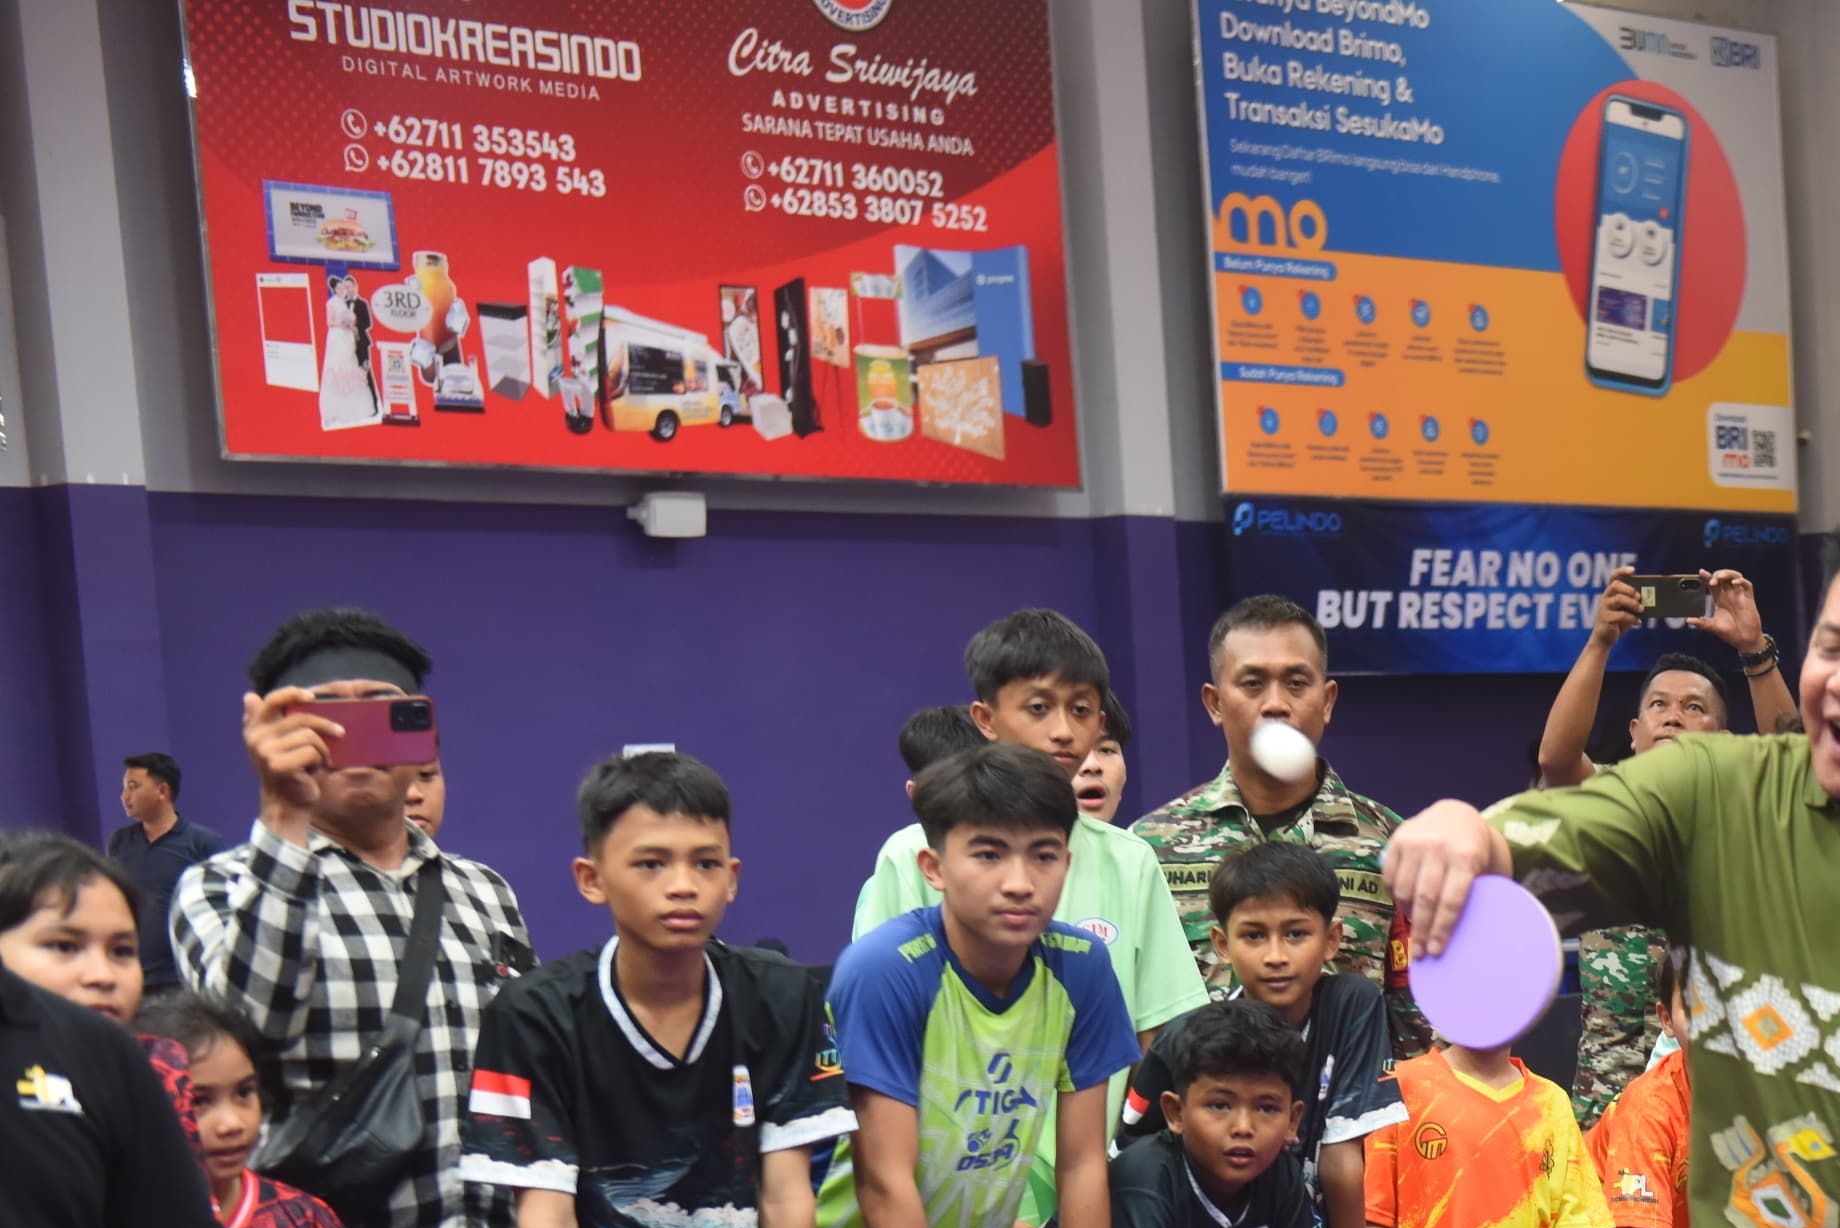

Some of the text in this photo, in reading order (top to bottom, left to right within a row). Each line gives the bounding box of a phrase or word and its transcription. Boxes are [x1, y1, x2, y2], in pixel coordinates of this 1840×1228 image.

[288, 0, 643, 82] STUDIOKREASINDO
[1220, 11, 1334, 54] Download
[341, 55, 601, 102] DIGITAL ARTWORK MEDIA
[727, 27, 979, 105] Citra Sriwijaya
[1222, 52, 1414, 106] Buka Rekening &
[771, 89, 946, 126] ADVERTISING
[1225, 92, 1445, 145] Transaksi SesukaMo
[374, 116, 577, 163] +62711 353543
[742, 112, 975, 156] SARANA TEPAT USAHA ANDA
[377, 150, 607, 198] +62811 7893 543
[768, 157, 944, 198] +62711 360052
[771, 189, 988, 232] +62853 3807 5252
[384, 290, 421, 310] 3RD
[1257, 510, 1342, 531] PELINDO
[1409, 549, 1503, 587] FEAR
[1506, 551, 1562, 588] NO
[1316, 590, 1393, 629] BUT
[1399, 592, 1557, 630] RESPECT
